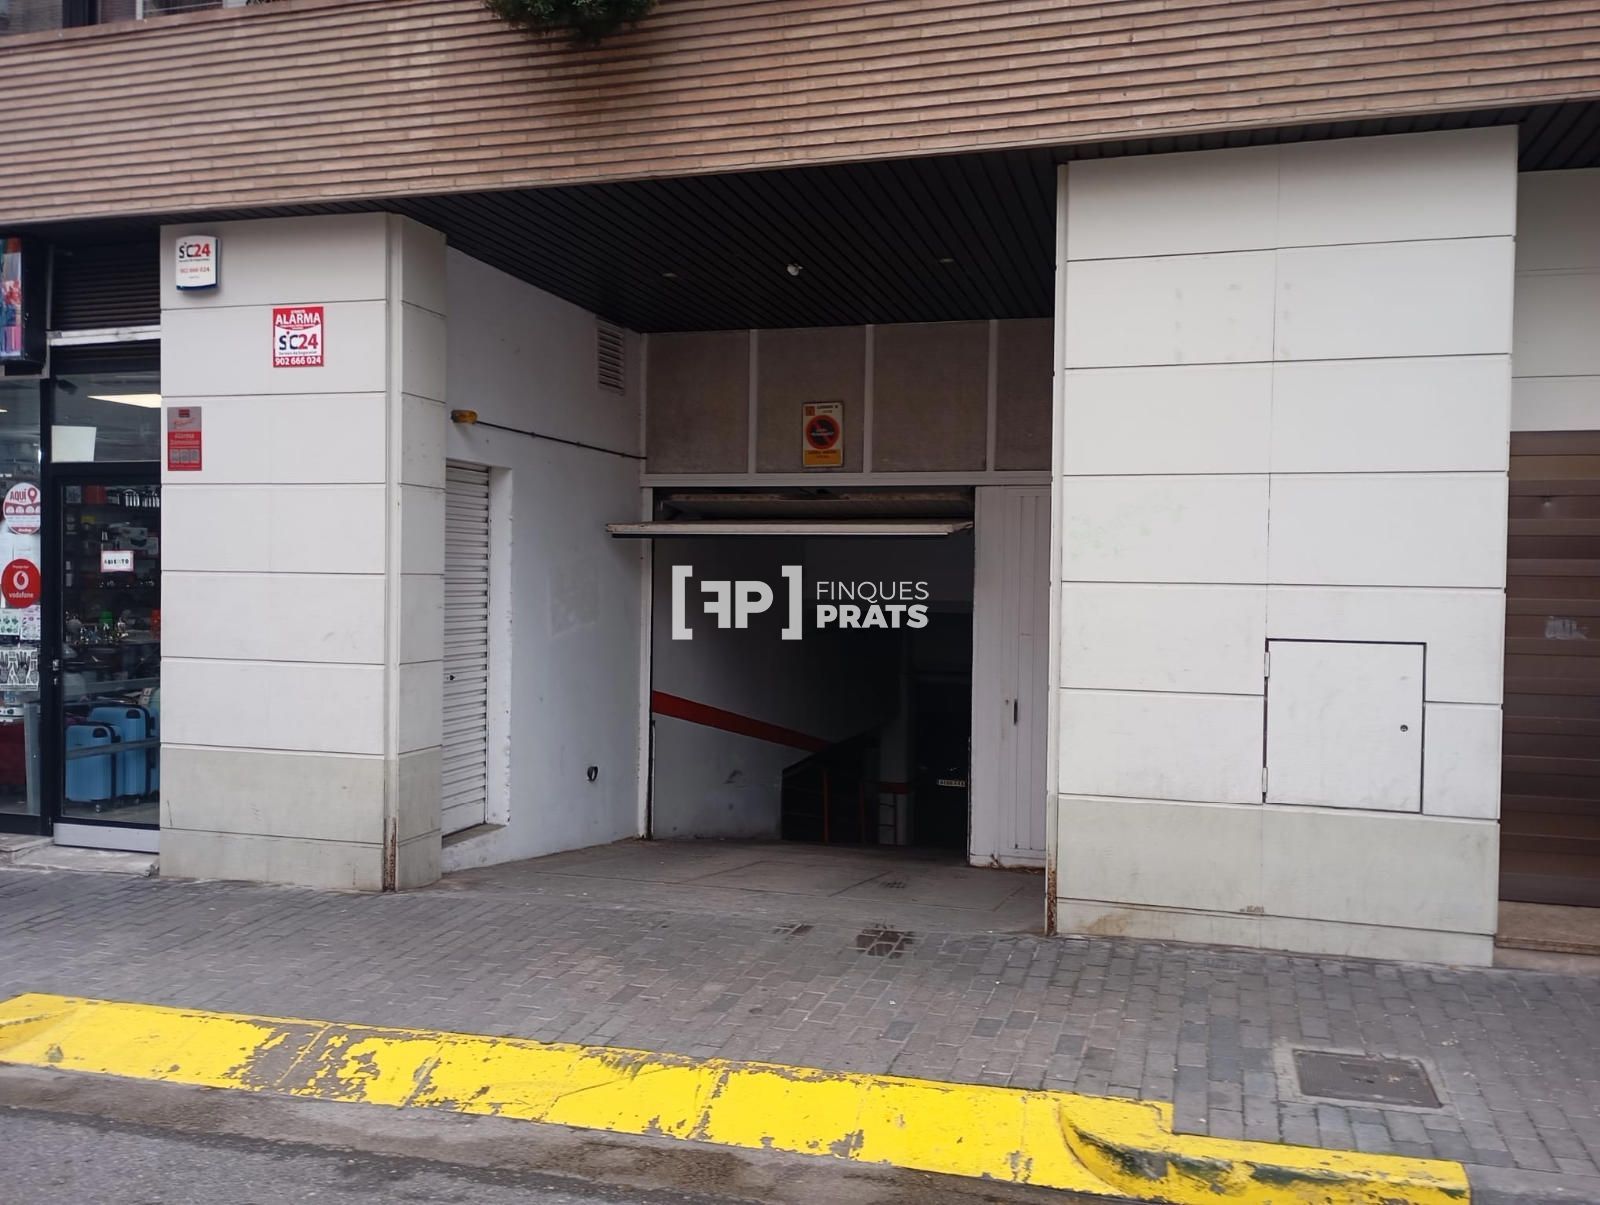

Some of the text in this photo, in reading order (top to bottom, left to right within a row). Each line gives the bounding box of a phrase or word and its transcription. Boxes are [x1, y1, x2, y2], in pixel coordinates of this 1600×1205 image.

[275, 311, 321, 325] ALARMA
[275, 356, 321, 366] 902 666 024
[8, 591, 34, 599] vodafone
